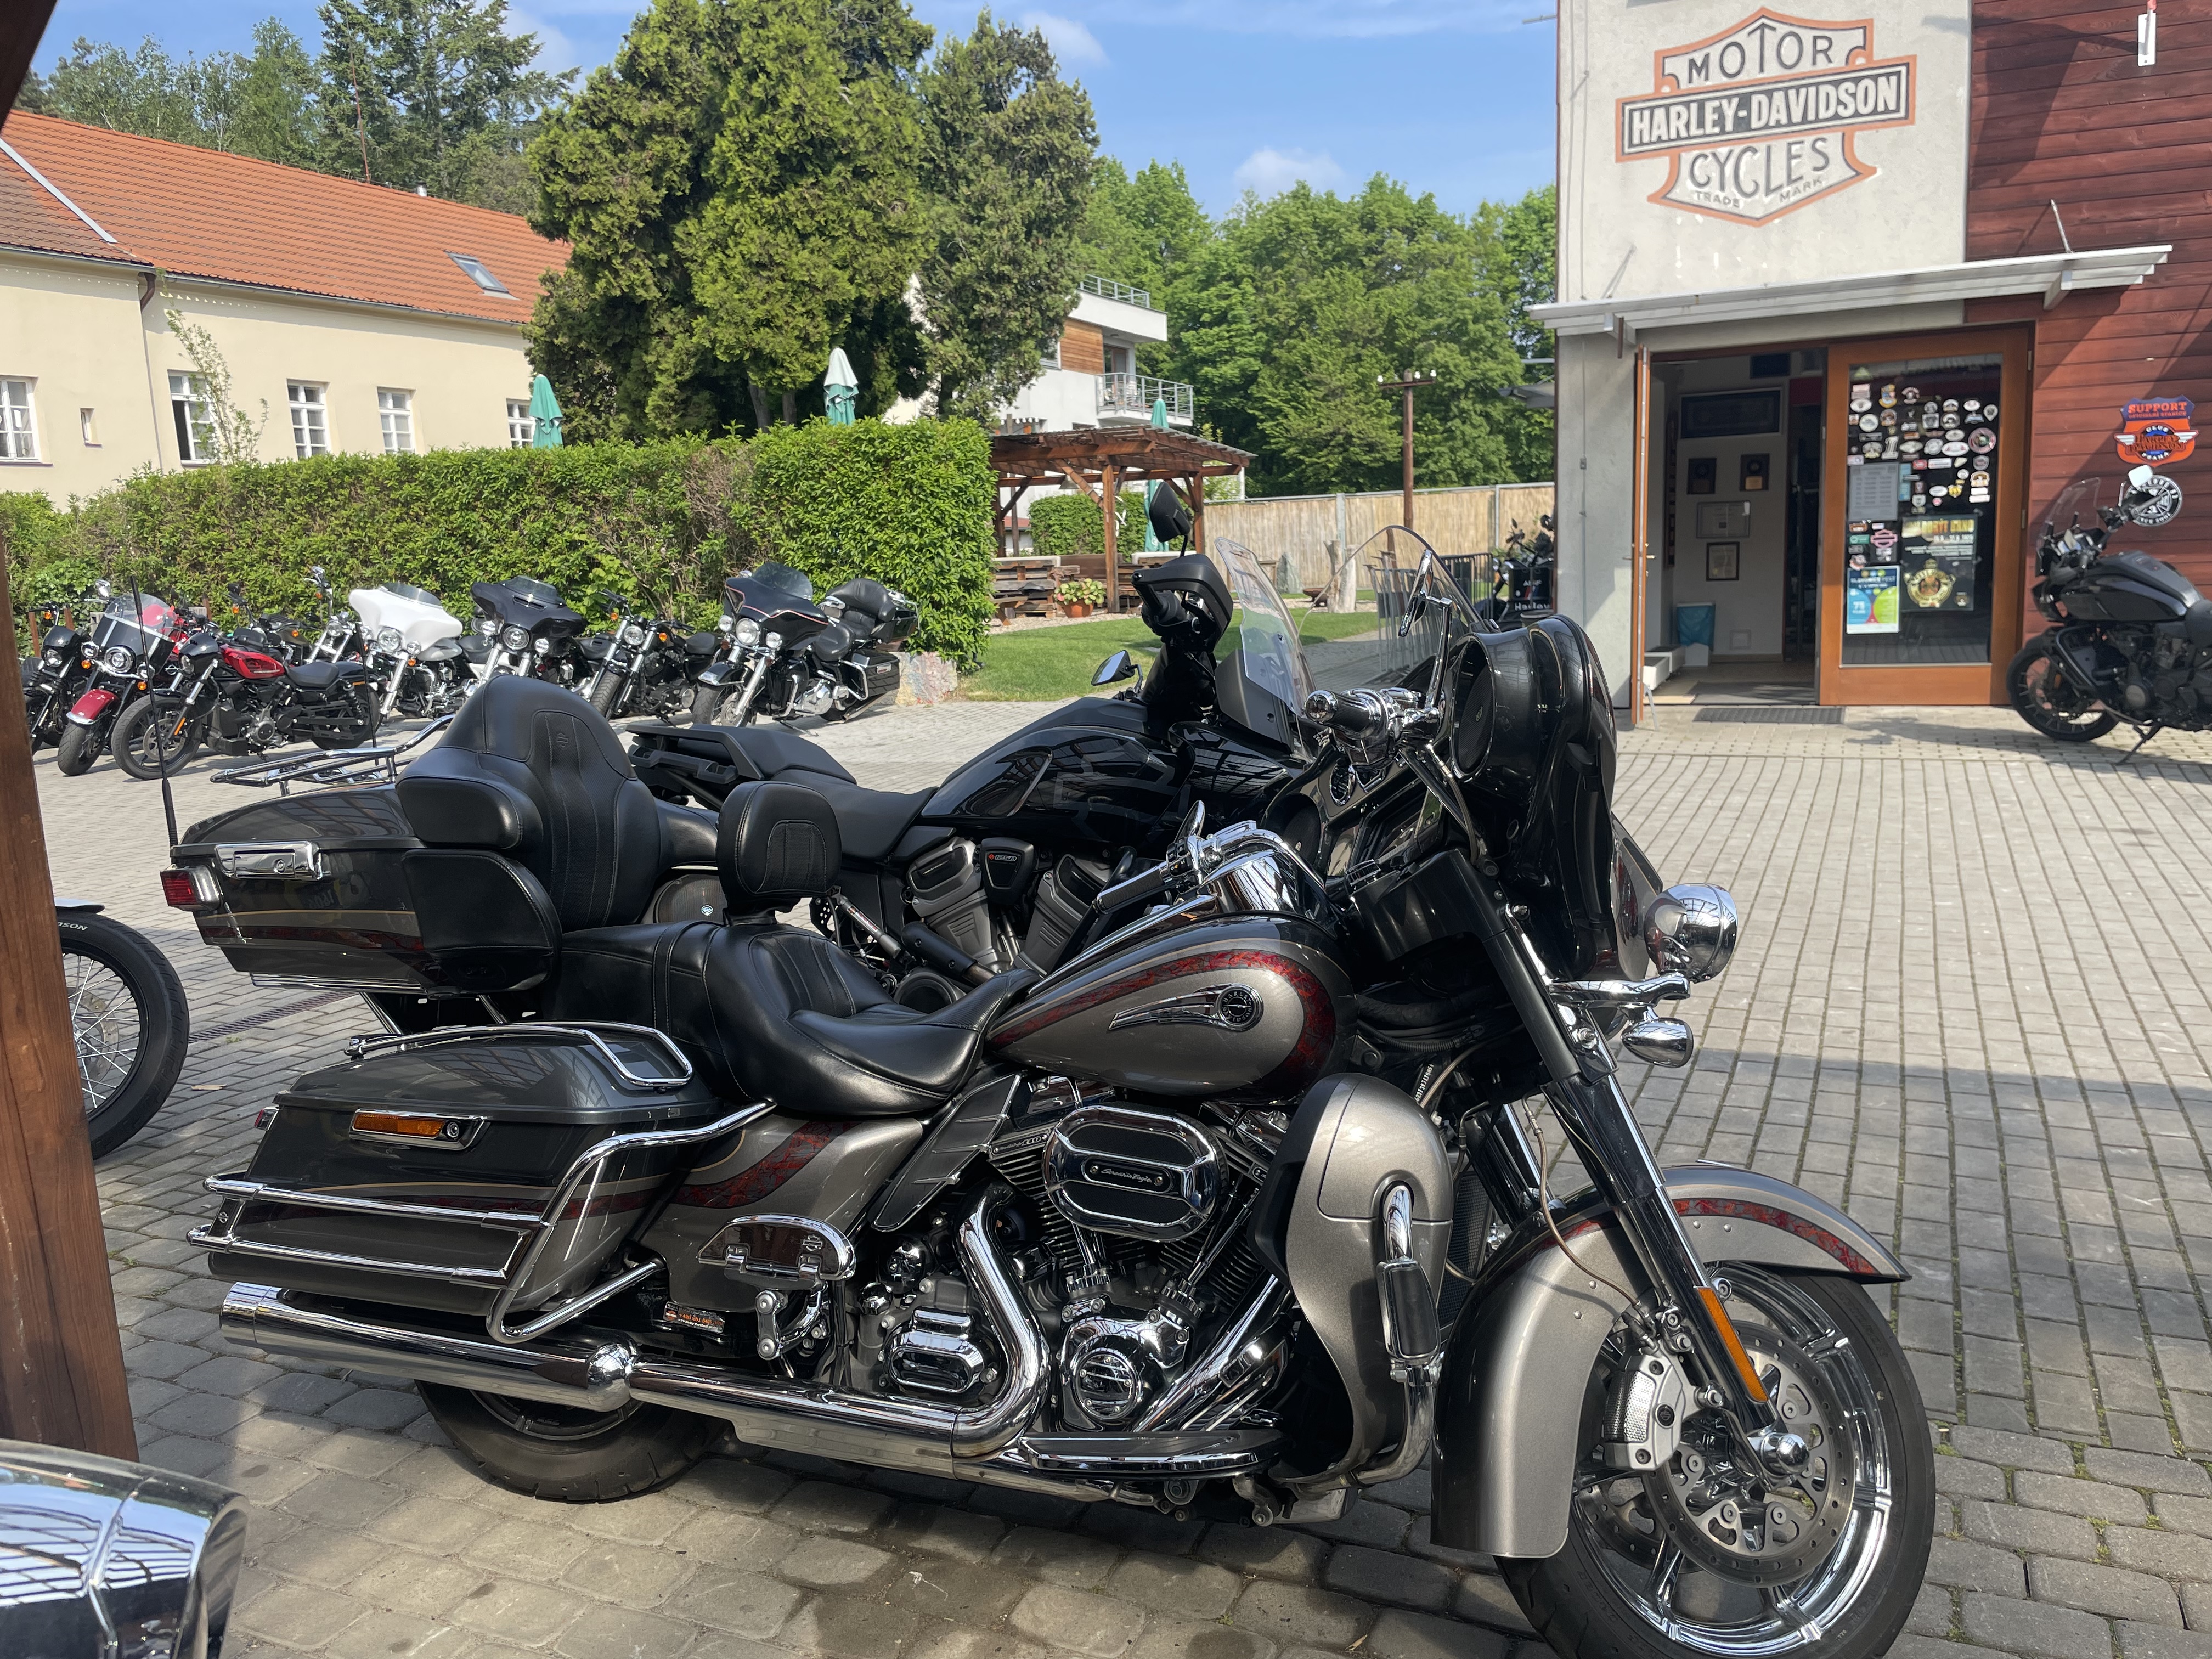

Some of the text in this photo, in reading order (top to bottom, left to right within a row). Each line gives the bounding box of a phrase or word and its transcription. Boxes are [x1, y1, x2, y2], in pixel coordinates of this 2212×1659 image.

[1688, 22, 1833, 84] MOTOR
[1631, 75, 1898, 145] HARLEY-DAVIDSON
[1689, 137, 1830, 198] CYCLES
[1694, 176, 1823, 208] TRADE MARK
[2128, 402, 2187, 413] SUPPORT
